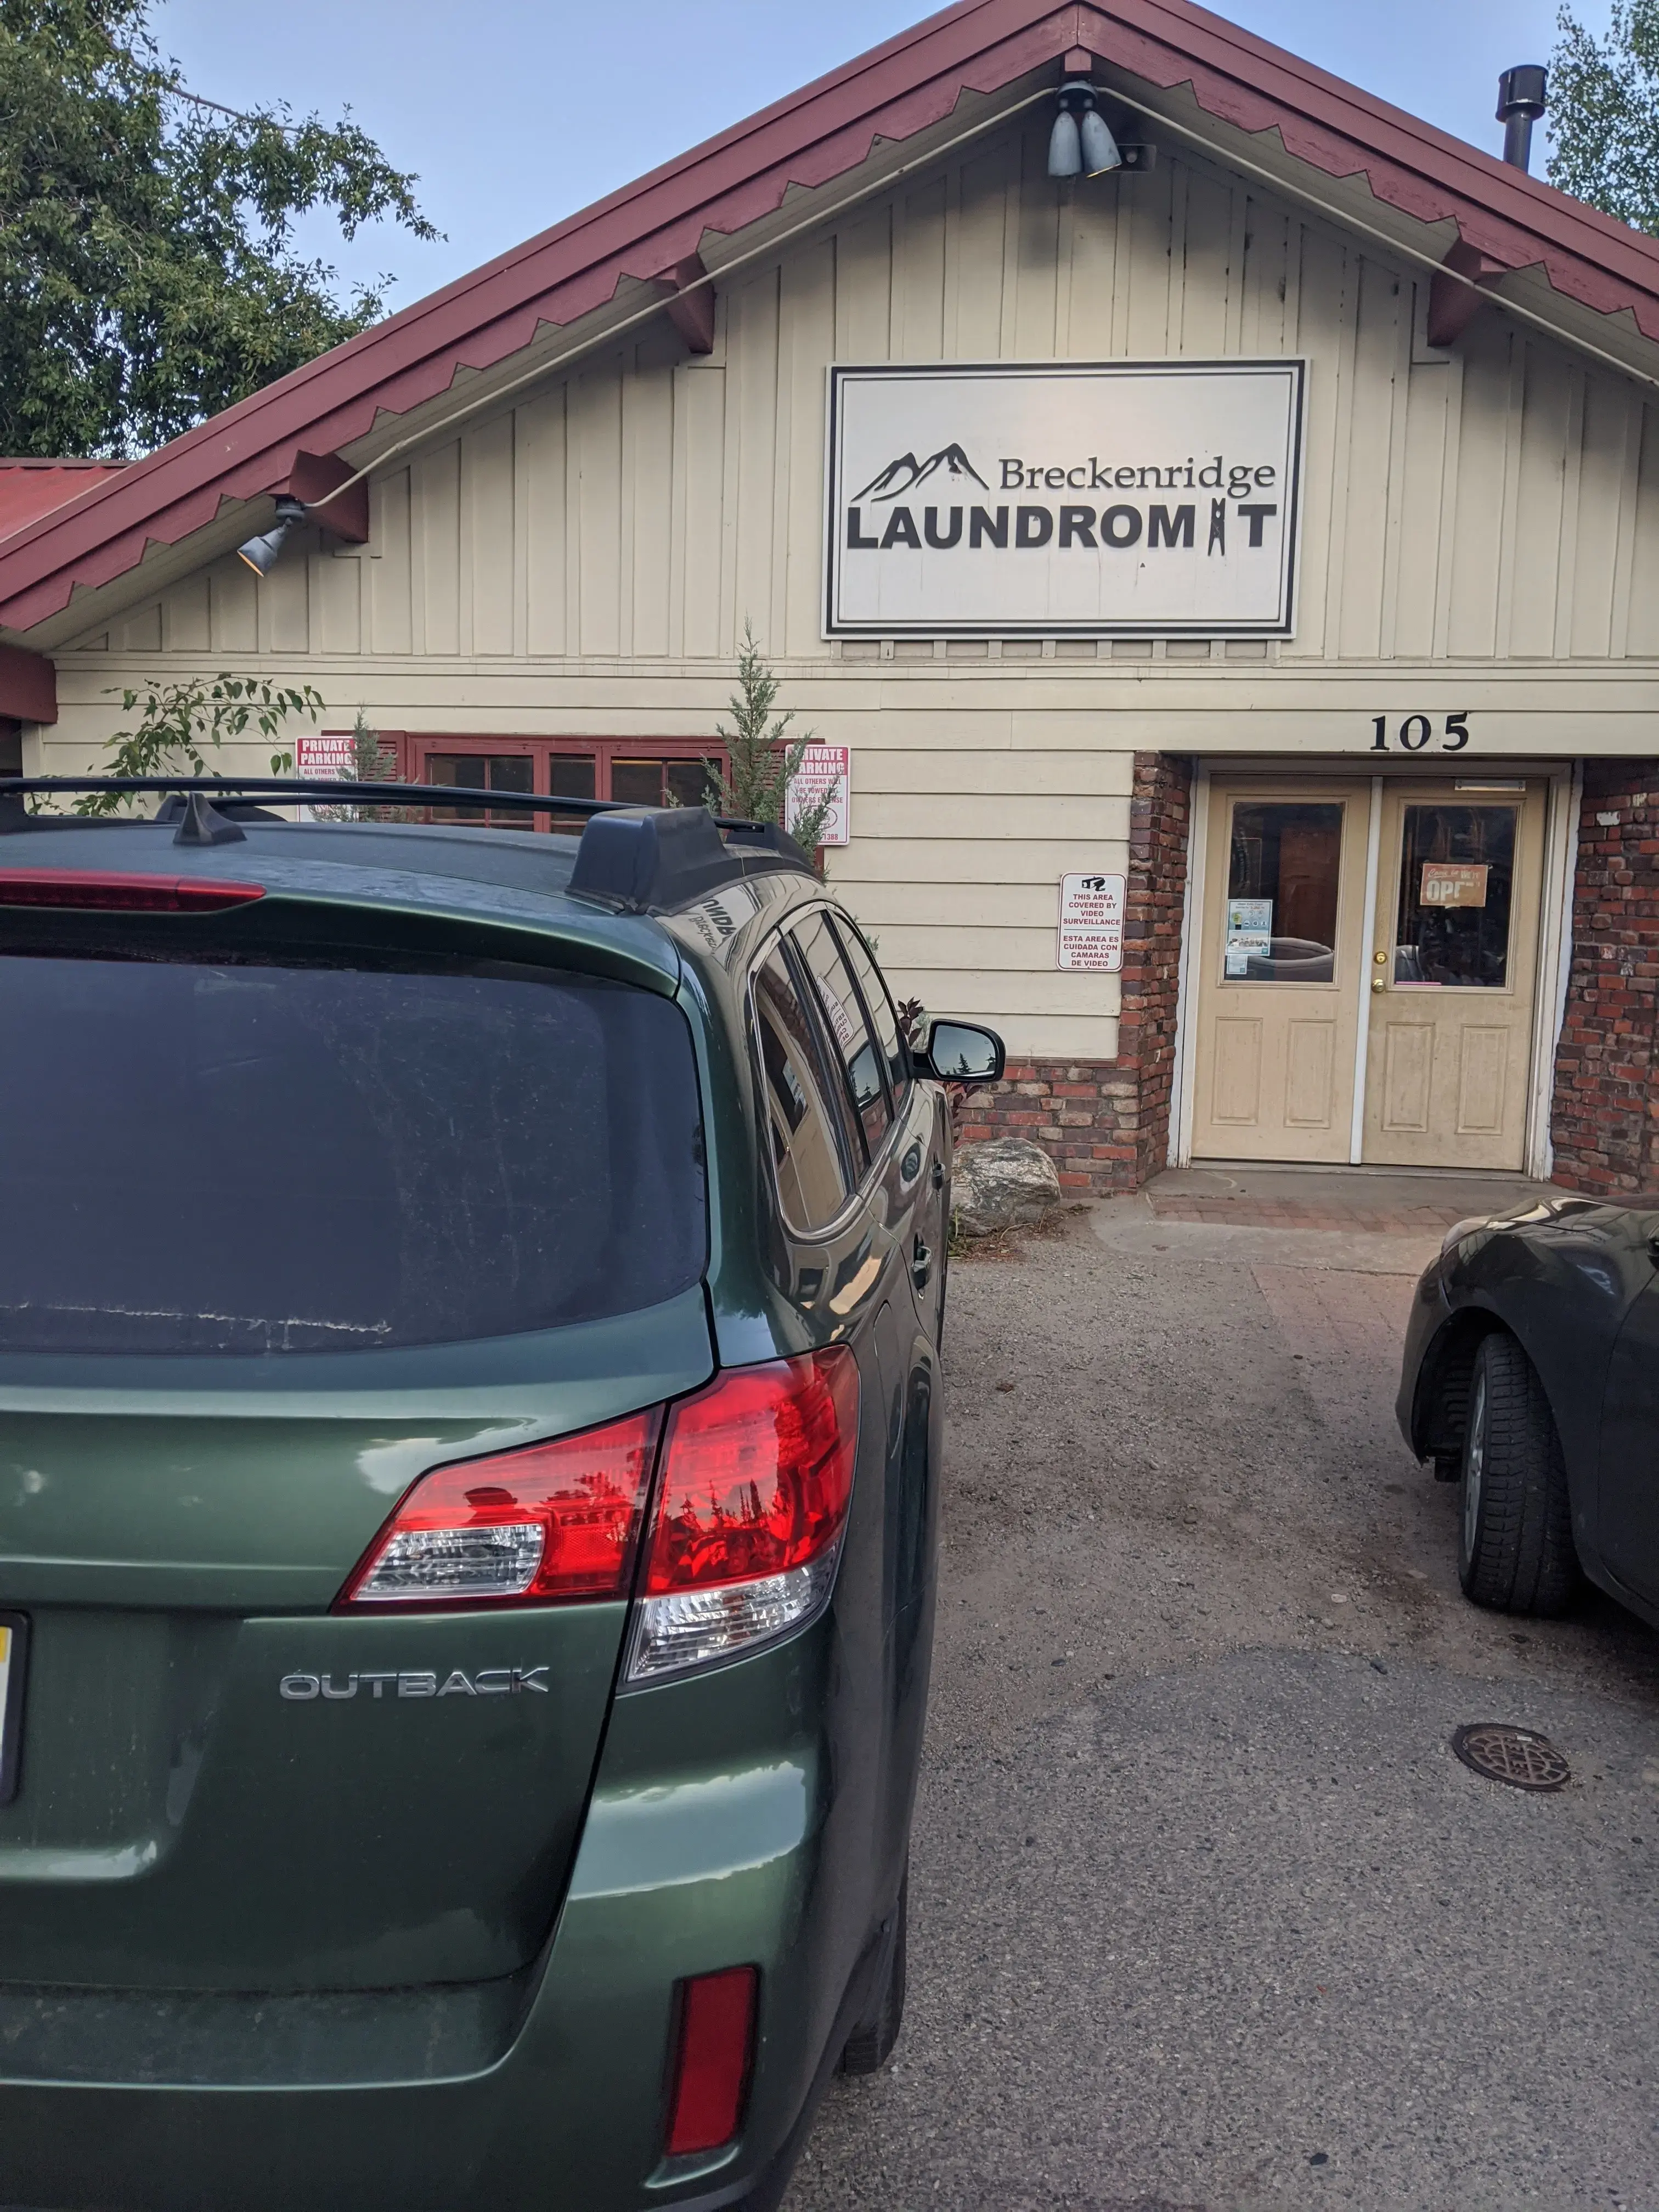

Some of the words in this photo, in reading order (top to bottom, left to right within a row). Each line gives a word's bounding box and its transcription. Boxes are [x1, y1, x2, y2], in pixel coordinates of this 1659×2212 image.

[998, 455, 1276, 498] Breckenridge
[1370, 712, 1469, 751] 105
[303, 740, 349, 752] PRIVATE
[301, 753, 352, 765] PARKING
[802, 748, 843, 760] RIVATE
[799, 762, 844, 774] ARKING
[279, 1666, 550, 1700] OUTBACK
